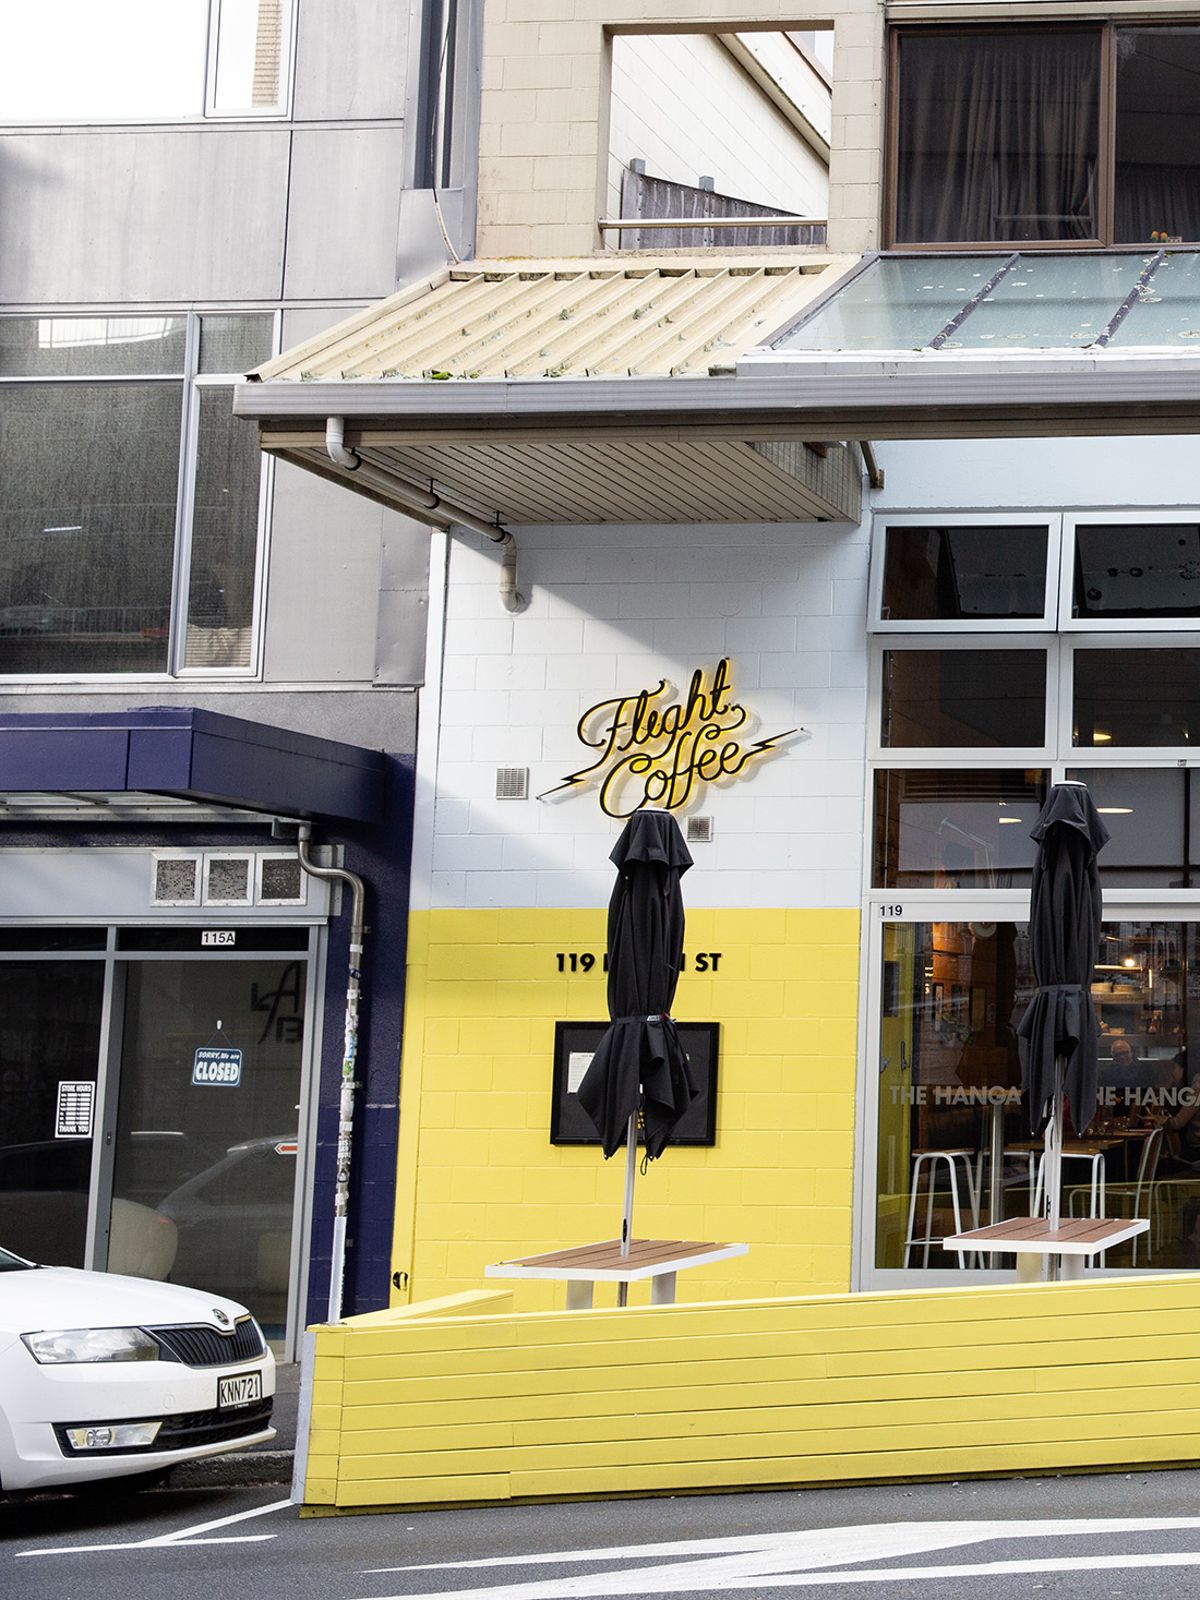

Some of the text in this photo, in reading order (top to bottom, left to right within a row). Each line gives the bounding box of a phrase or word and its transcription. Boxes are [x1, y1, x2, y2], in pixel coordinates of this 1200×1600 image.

[599, 704, 748, 819] Coffee
[879, 905, 903, 917] 119
[203, 932, 235, 944] 115A
[556, 953, 595, 972] 119
[695, 953, 722, 972] ST
[196, 1061, 239, 1081] CLOSED
[890, 1085, 1022, 1105] THE HANGA
[1096, 1086, 1117, 1106] HE
[220, 1376, 259, 1405] KNN721
